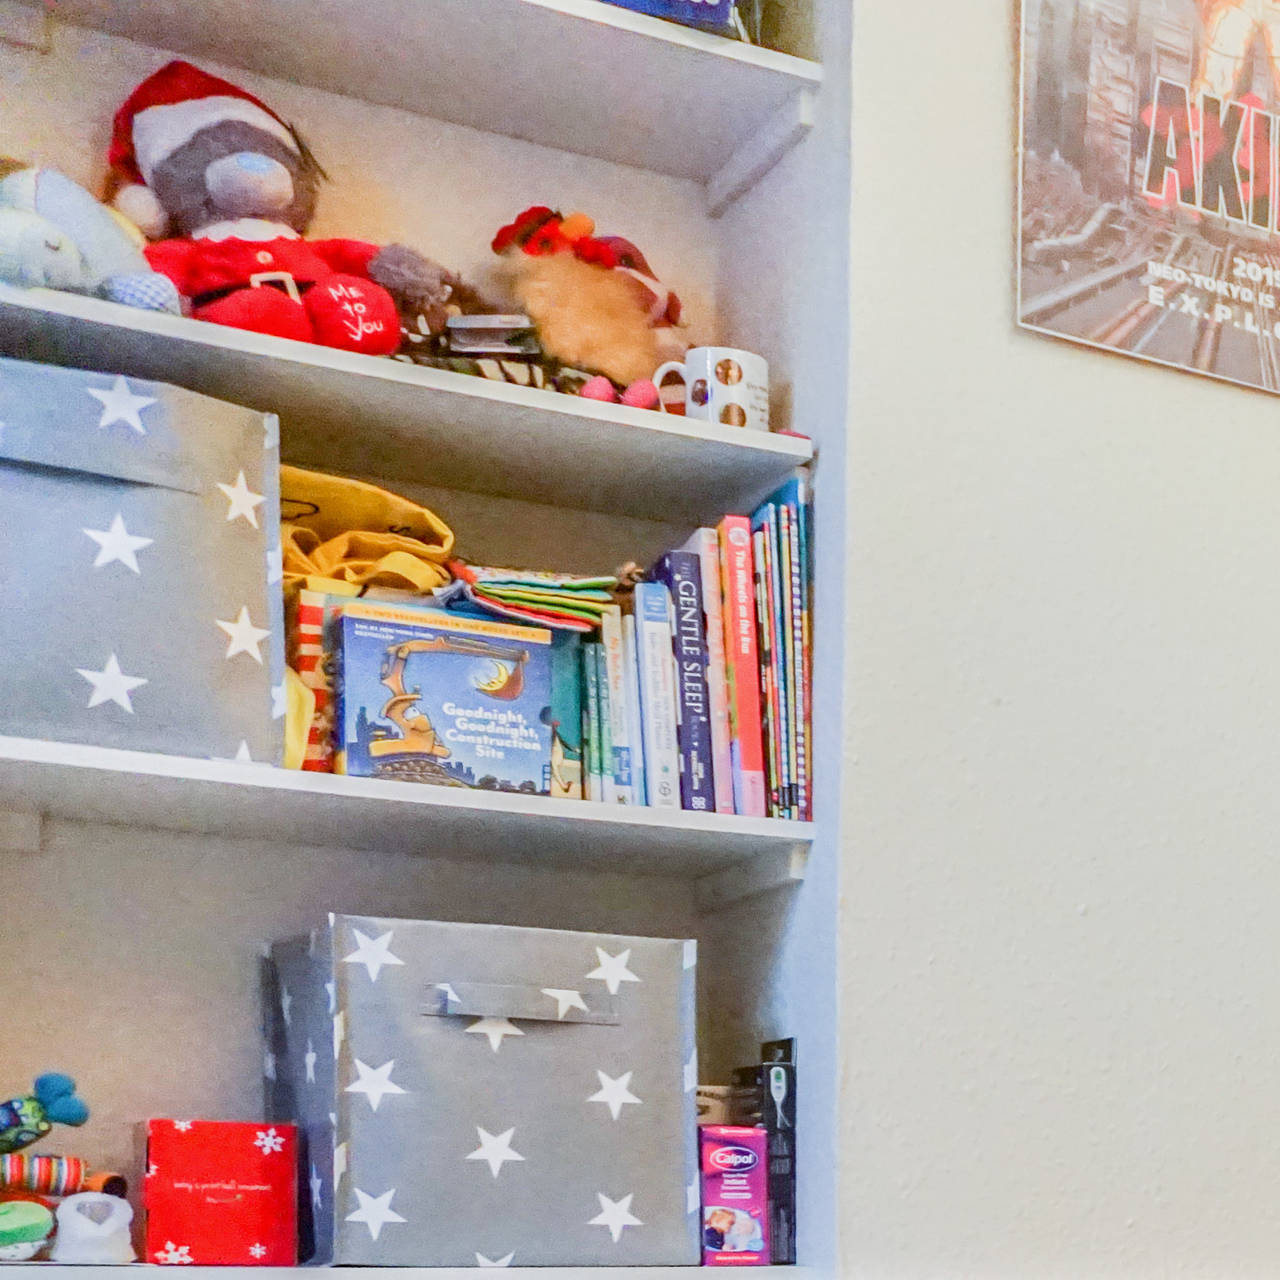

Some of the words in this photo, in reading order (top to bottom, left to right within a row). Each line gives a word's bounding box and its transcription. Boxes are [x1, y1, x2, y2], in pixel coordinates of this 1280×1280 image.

[1258, 290, 1275, 309] IS
[342, 315, 384, 341] You
[735, 551, 746, 568] The
[678, 580, 700, 656] GENTLE
[683, 661, 704, 713] SLEEP
[442, 702, 527, 725] Goodnight,
[445, 728, 541, 751] Construction
[455, 717, 539, 740] Goodnight,
[475, 744, 505, 760] Site
[714, 1152, 753, 1167] Calpol
